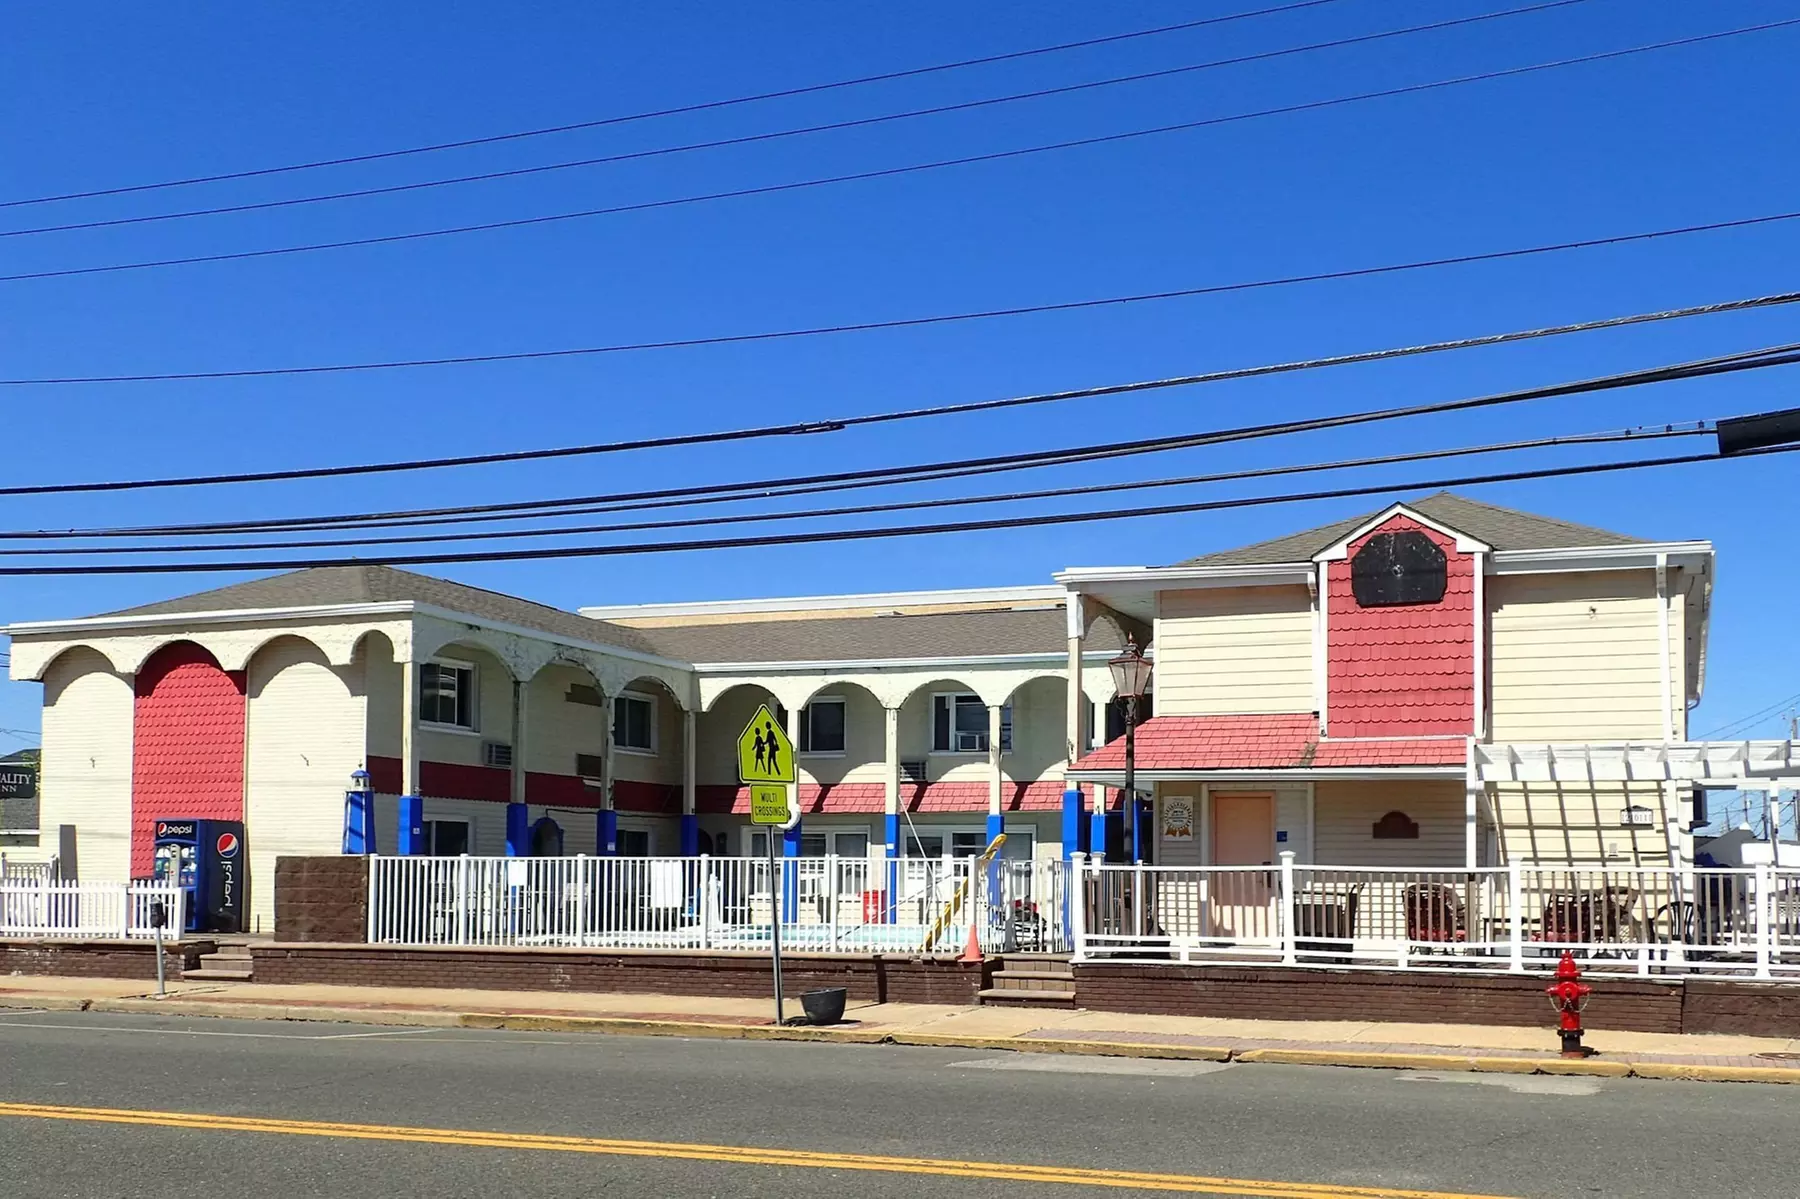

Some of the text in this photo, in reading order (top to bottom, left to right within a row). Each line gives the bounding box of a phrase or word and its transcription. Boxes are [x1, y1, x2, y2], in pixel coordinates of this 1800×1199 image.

[0, 773, 31, 784] ALITY
[761, 792, 777, 802] MULTI
[755, 805, 785, 816] CROSSINGS
[167, 825, 192, 834] pepsi
[221, 861, 233, 906] pepsi
